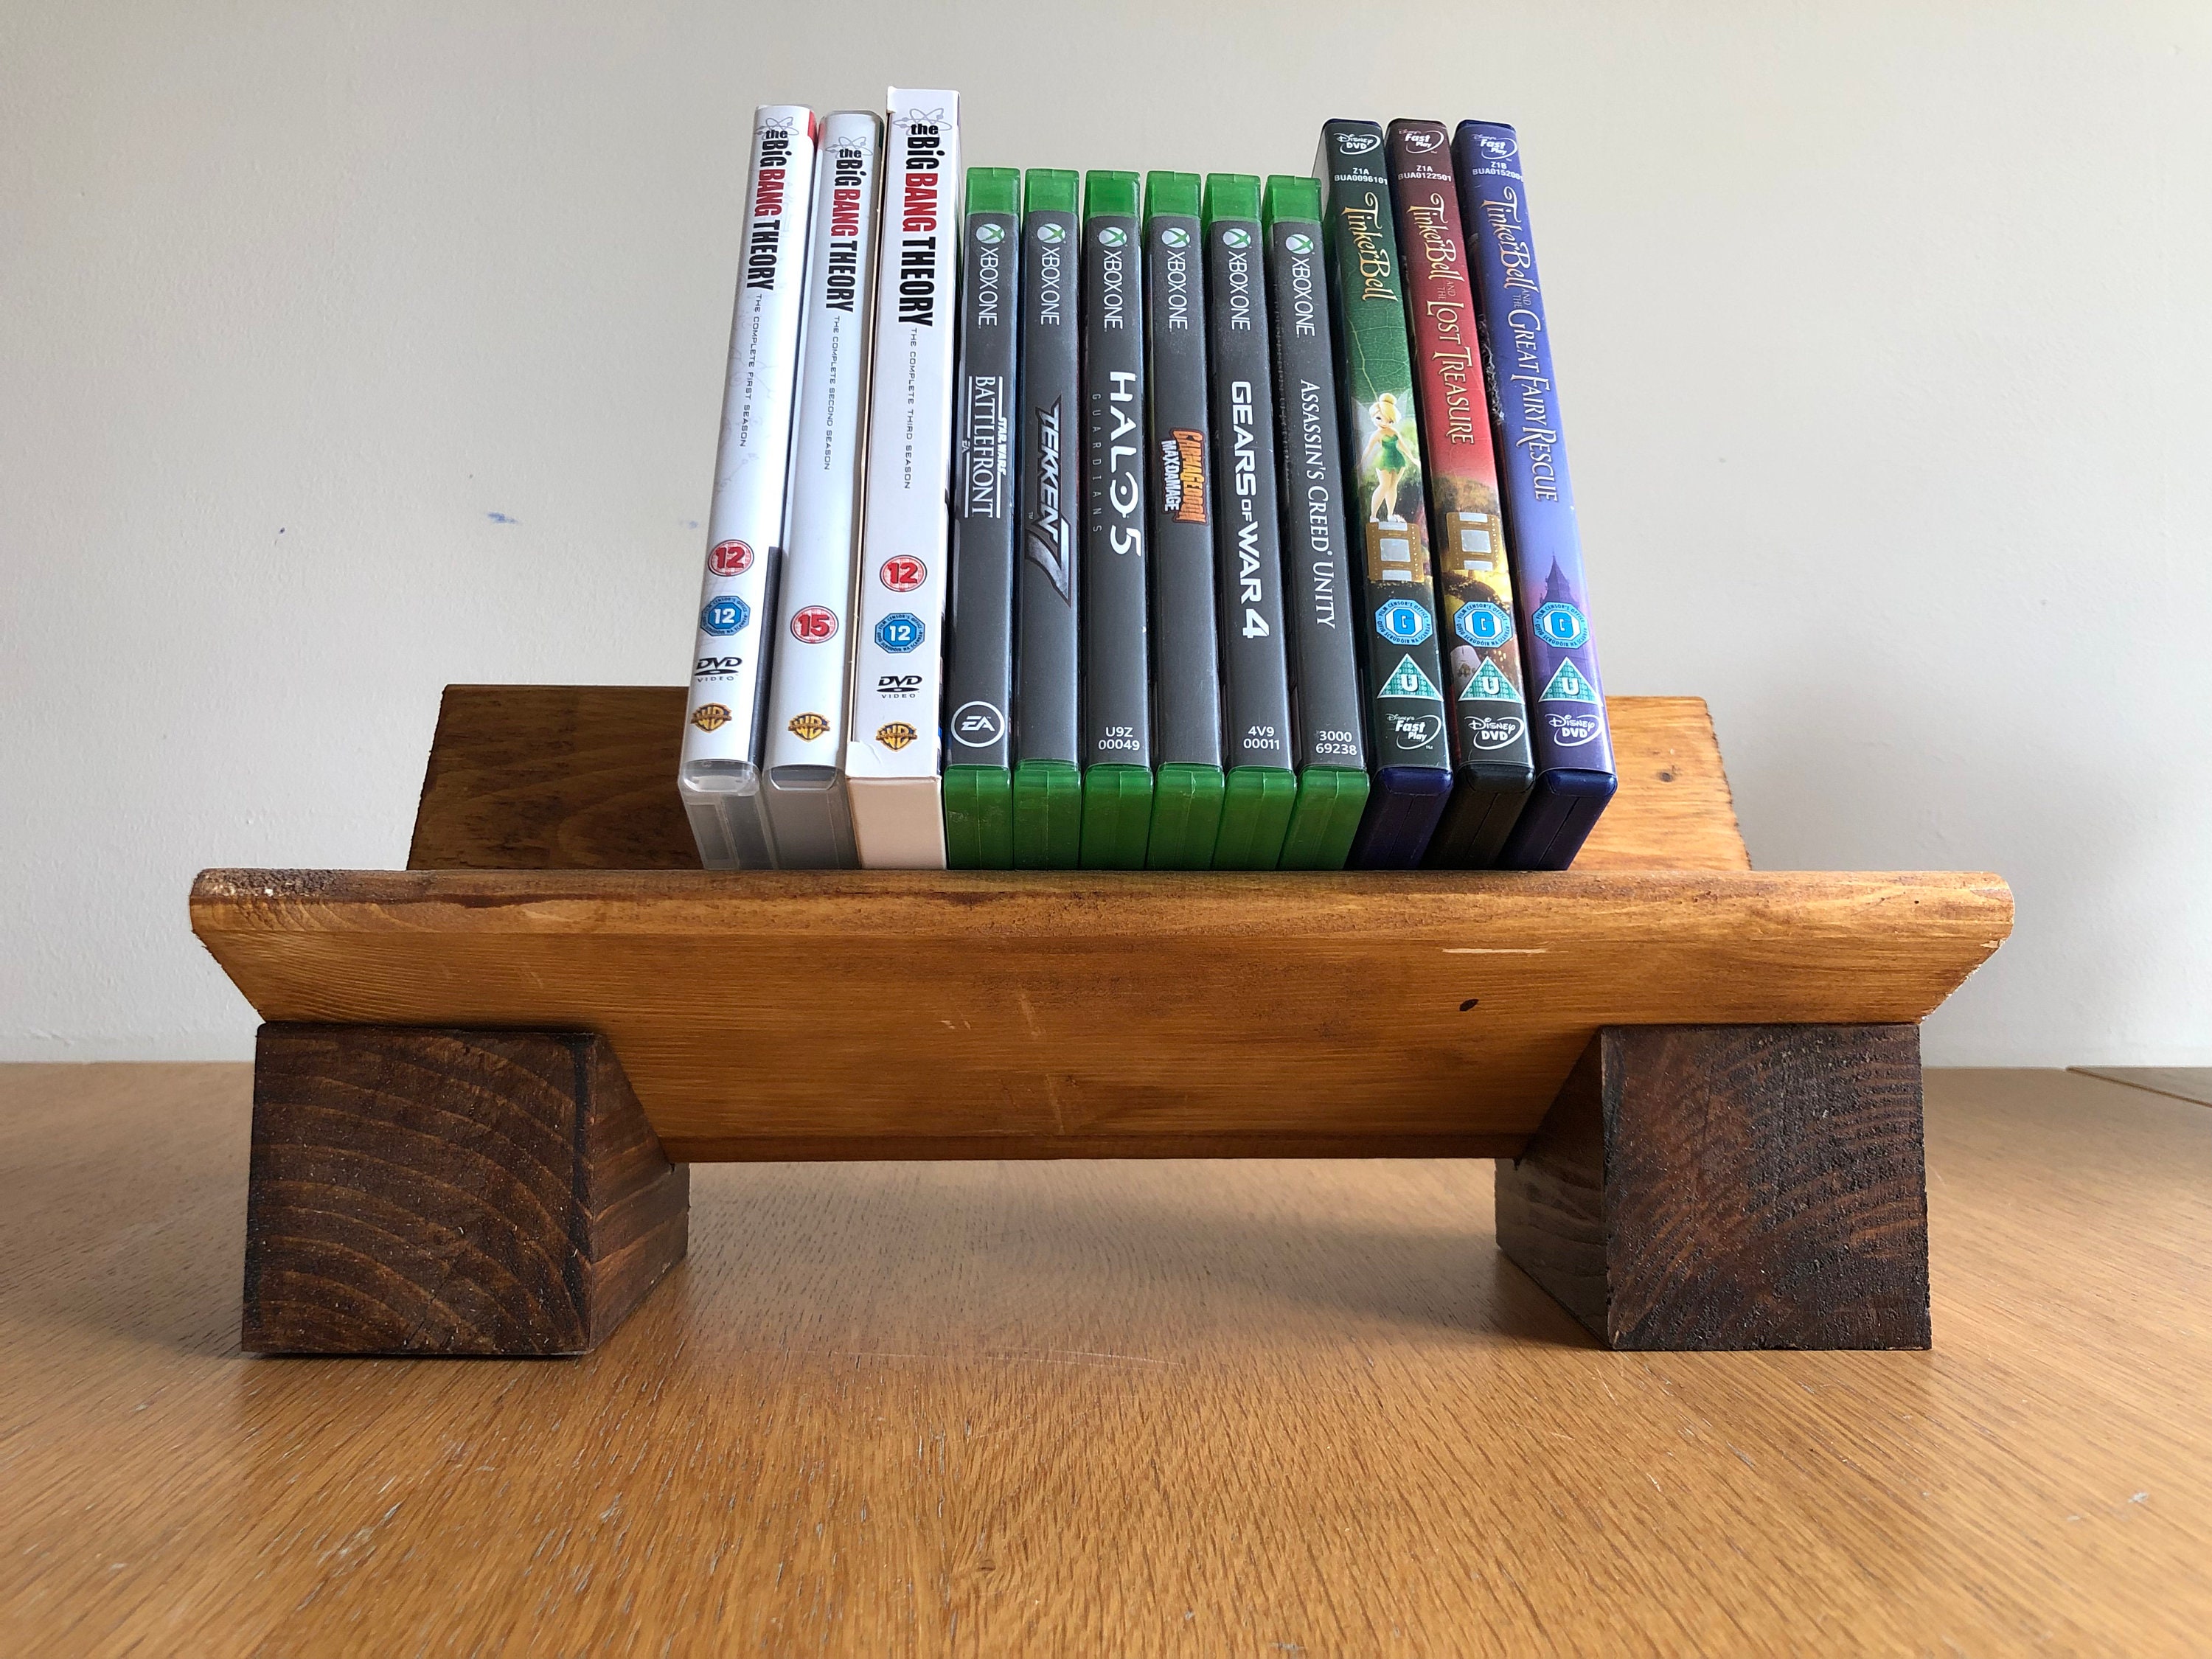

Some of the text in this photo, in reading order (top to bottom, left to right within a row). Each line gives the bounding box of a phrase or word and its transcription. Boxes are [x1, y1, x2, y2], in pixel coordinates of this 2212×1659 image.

[765, 129, 788, 140] the
[911, 122, 939, 136] the
[1405, 133, 1430, 142] Fast
[839, 147, 862, 159] the
[1480, 139, 1506, 149] Fast
[1397, 172, 1452, 182] BUA0122501
[1490, 161, 1507, 169] Z1B
[1334, 174, 1388, 185] BUA0096101
[754, 169, 787, 218] BANG
[902, 173, 939, 232] BANG
[830, 189, 861, 237] BANG
[746, 219, 781, 291] THEORY
[825, 240, 858, 313] THEORY
[898, 236, 936, 327] THEORY
[978, 246, 999, 326] XBOX ONE
[1040, 246, 1060, 326] XBOX ONE
[1445, 280, 1456, 297] AND
[1103, 250, 1124, 330] XBOX ONE
[1167, 250, 1188, 330] XBOX ONE
[1228, 251, 1251, 330] XBOX ONE
[1291, 256, 1315, 337] XBOX ONE
[1437, 287, 1446, 300] THE
[1512, 294, 1523, 308] THE
[1521, 288, 1531, 306] AND
[1426, 300, 1464, 346] LOST
[1507, 309, 1541, 373] GREAT
[740, 293, 762, 448] THE COMPLETE FIRST SEASON
[824, 316, 841, 470] THE COMPLETE SECOND SEASON
[1432, 347, 1474, 445] TREASURE
[1510, 374, 1550, 426] FAIRY
[903, 327, 918, 490] THE COMPLETE THIRD SEASON
[1301, 378, 1326, 481] ASSASSIN'S
[972, 376, 995, 518] BATTLEFRONT
[997, 417, 1007, 476] STAR WARS
[1037, 402, 1060, 544] TEKKEN
[1091, 393, 1102, 532] GUARDIANS
[1110, 371, 1141, 557] HALO 5
[1516, 426, 1559, 502] RESCUE
[1172, 430, 1206, 523] CARMAGEDDON
[1231, 380, 1270, 639] GEARS OF WAR 4
[715, 548, 745, 571] 12
[887, 563, 918, 584] 12
[1312, 560, 1336, 630] UNITY
[714, 608, 736, 625] 12
[798, 613, 830, 637] 15
[1393, 609, 1416, 635] G
[1472, 611, 1495, 637] G
[1551, 612, 1573, 638] G
[889, 625, 911, 641] 12
[697, 657, 742, 670] DVD
[878, 675, 922, 687] DVD
[1401, 674, 1418, 692] U
[1482, 676, 1500, 695] U
[1561, 677, 1579, 695] U
[961, 715, 995, 731] EA
[1105, 726, 1133, 737] U9Z
[1248, 726, 1275, 737] 4V9
[1395, 720, 1425, 733] Fast
[1562, 727, 1588, 738] DVD
[1098, 738, 1140, 751] 00049
[1243, 737, 1280, 751] 00011
[1319, 730, 1352, 742] 3000
[1408, 731, 1427, 742] Play
[1481, 730, 1509, 741] DVD
[1315, 742, 1357, 756] 69238
